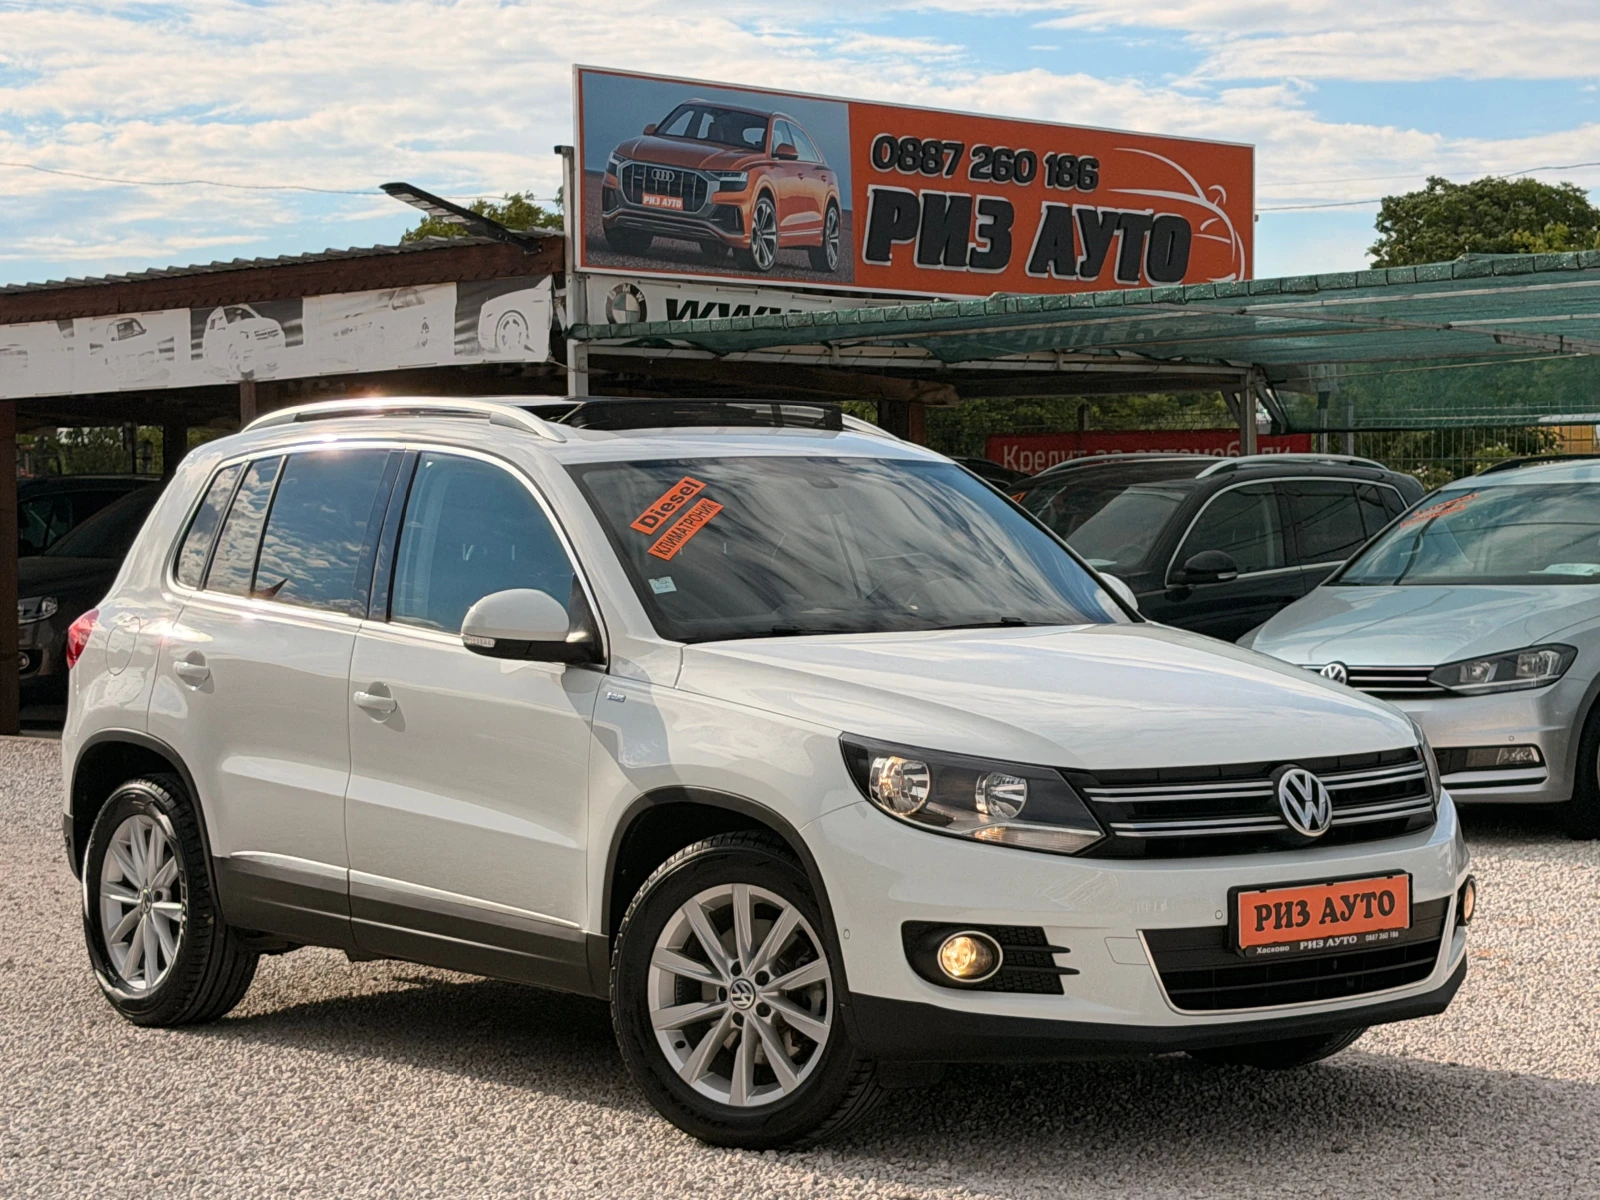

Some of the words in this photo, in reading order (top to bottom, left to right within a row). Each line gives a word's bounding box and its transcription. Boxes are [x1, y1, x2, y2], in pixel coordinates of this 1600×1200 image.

[870, 133, 965, 178] 0887
[967, 144, 1038, 185] 260
[1044, 152, 1100, 192] 186
[643, 195, 660, 206] РИЗ
[661, 198, 682, 209] АУТО
[862, 185, 1015, 273] РИЗ
[1026, 202, 1192, 288] АУТО
[1003, 445, 1088, 473] Кредит
[637, 480, 701, 529] Diesel
[653, 500, 718, 556] КЛИМАТРОНИК
[1254, 899, 1311, 932] РИЗ
[1319, 889, 1396, 925] АУТО
[1300, 939, 1324, 951] РИЗ
[1325, 935, 1357, 947] АУТО
